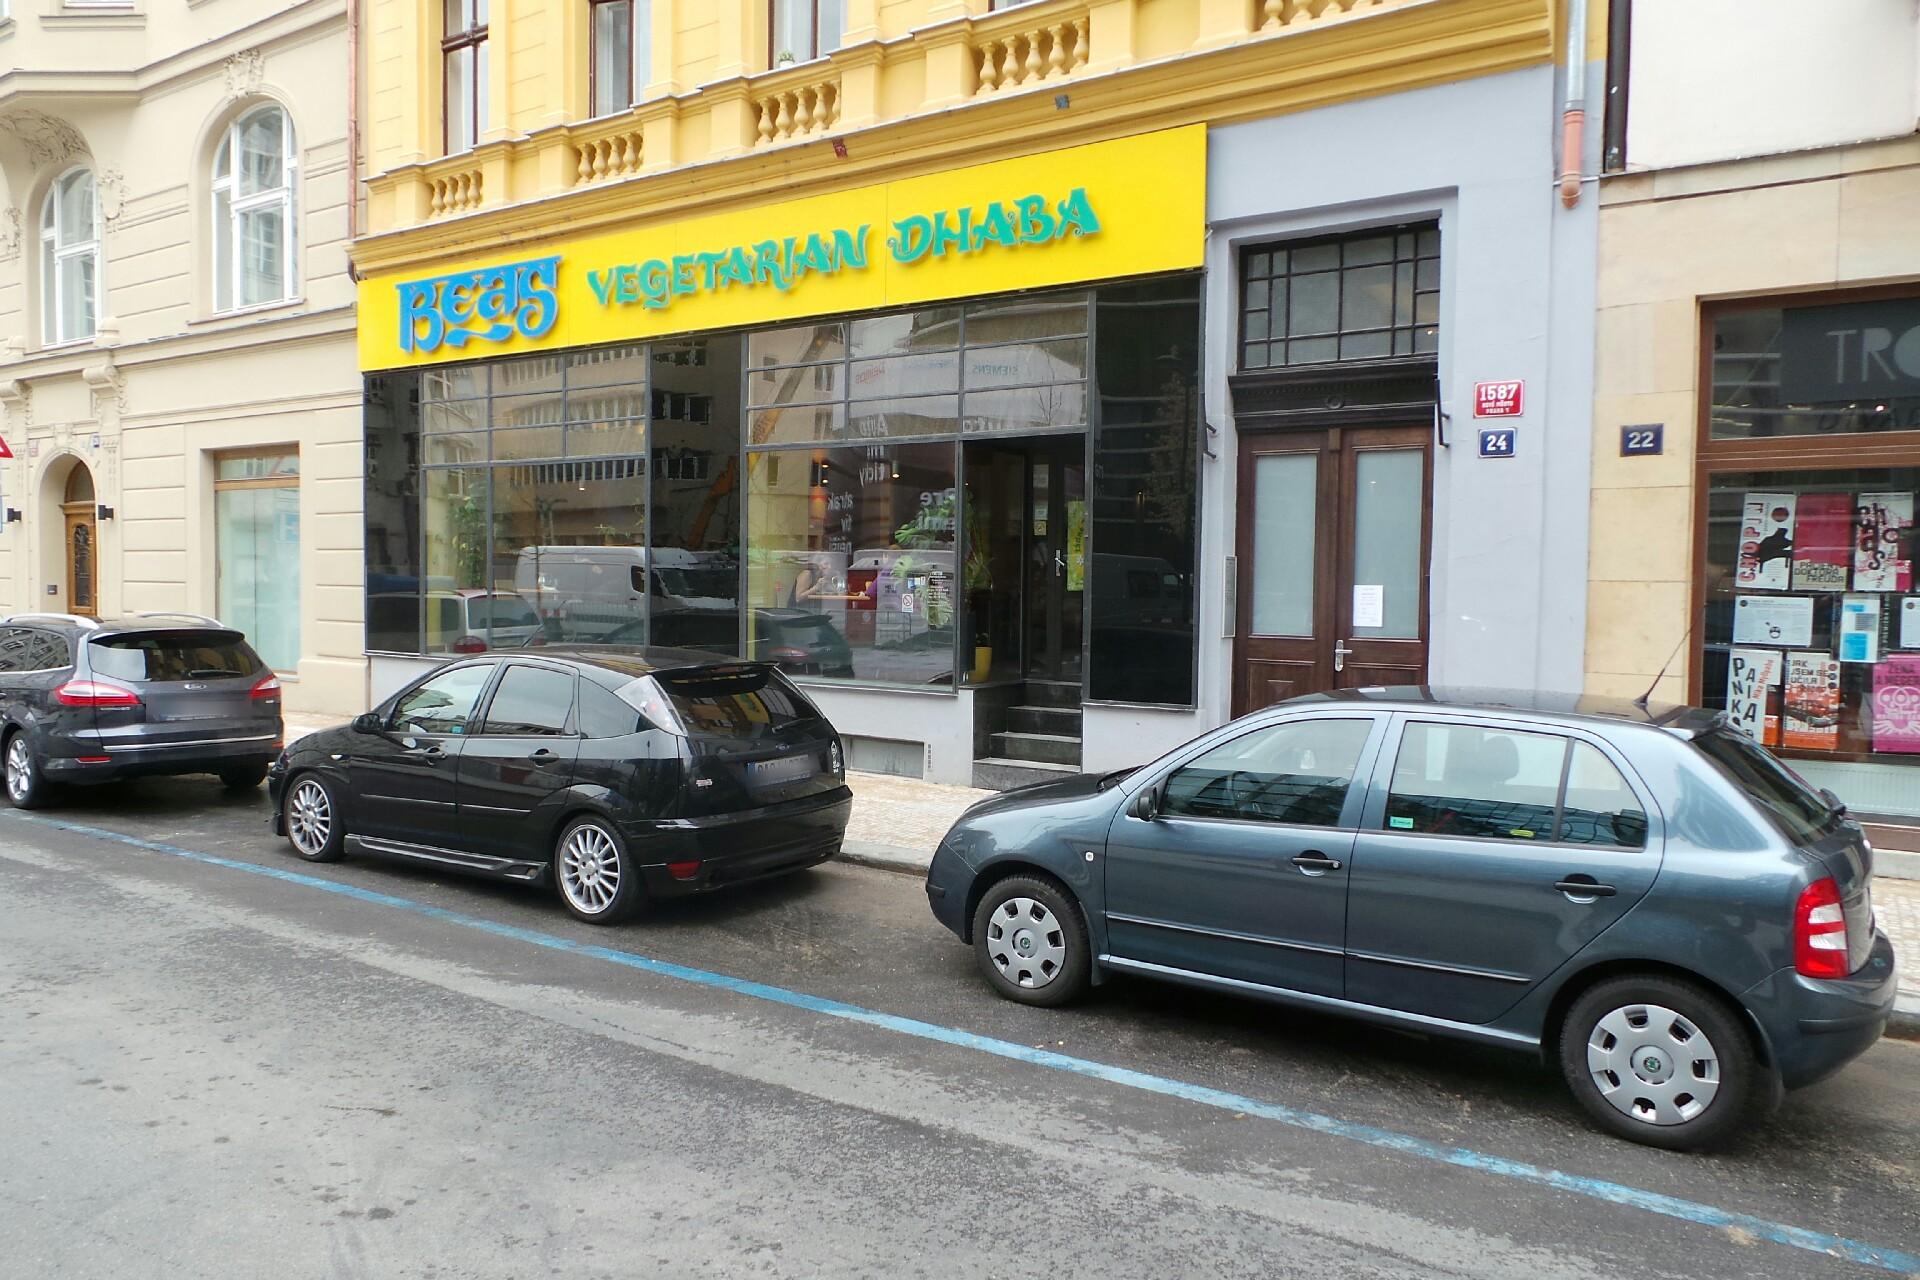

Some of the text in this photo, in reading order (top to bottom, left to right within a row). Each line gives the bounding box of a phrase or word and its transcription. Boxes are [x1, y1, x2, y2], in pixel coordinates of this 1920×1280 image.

[587, 187, 1101, 308] VEGETARIAN DHABA
[1480, 384, 1518, 401] 1587
[1486, 434, 1508, 452] 24
[1628, 432, 1654, 449] 22
